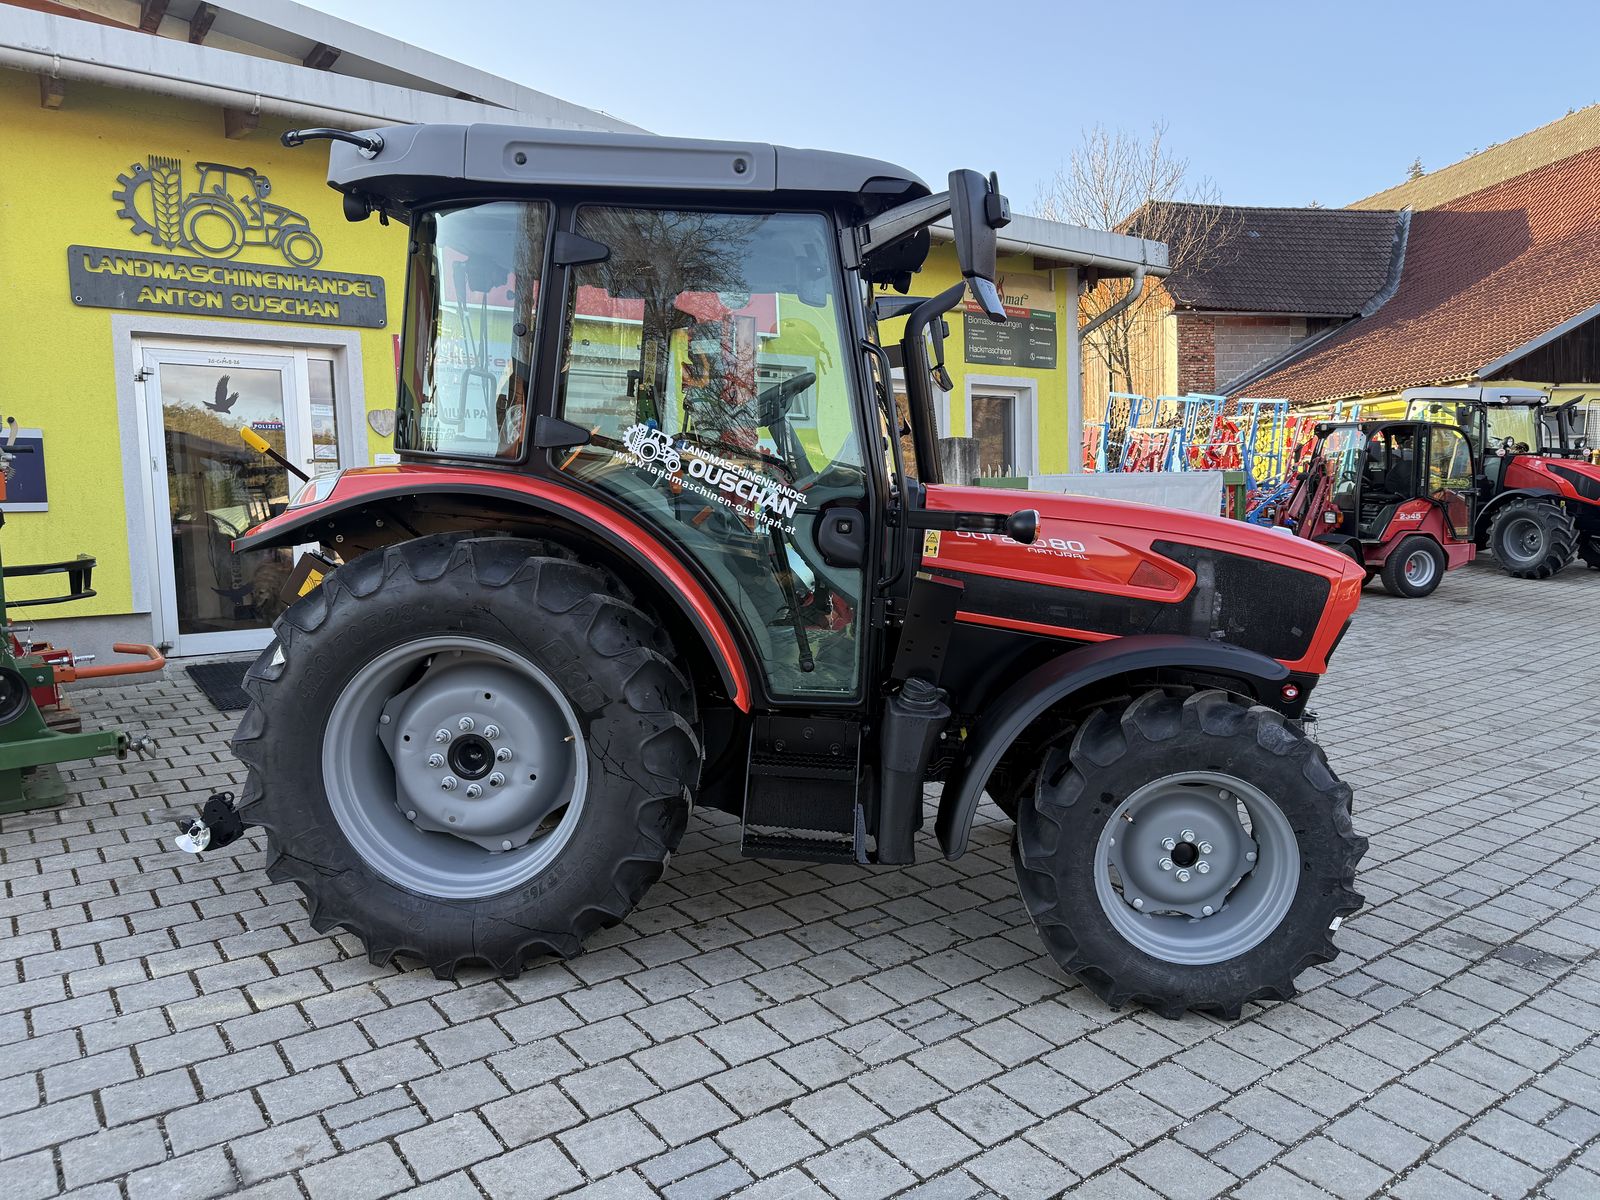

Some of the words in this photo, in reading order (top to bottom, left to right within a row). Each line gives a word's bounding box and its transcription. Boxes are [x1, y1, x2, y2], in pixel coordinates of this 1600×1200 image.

[82, 254, 377, 299] LANDMASCHINENHANDEL
[137, 285, 223, 309] ANTON
[231, 292, 340, 319] OUSCHAN
[615, 450, 796, 535] www.landmaschinen-ouschan.at
[681, 441, 807, 505] LANDMASCHINENHANDEL
[688, 459, 798, 519] OUSCHAN
[1049, 538, 1086, 553] 80
